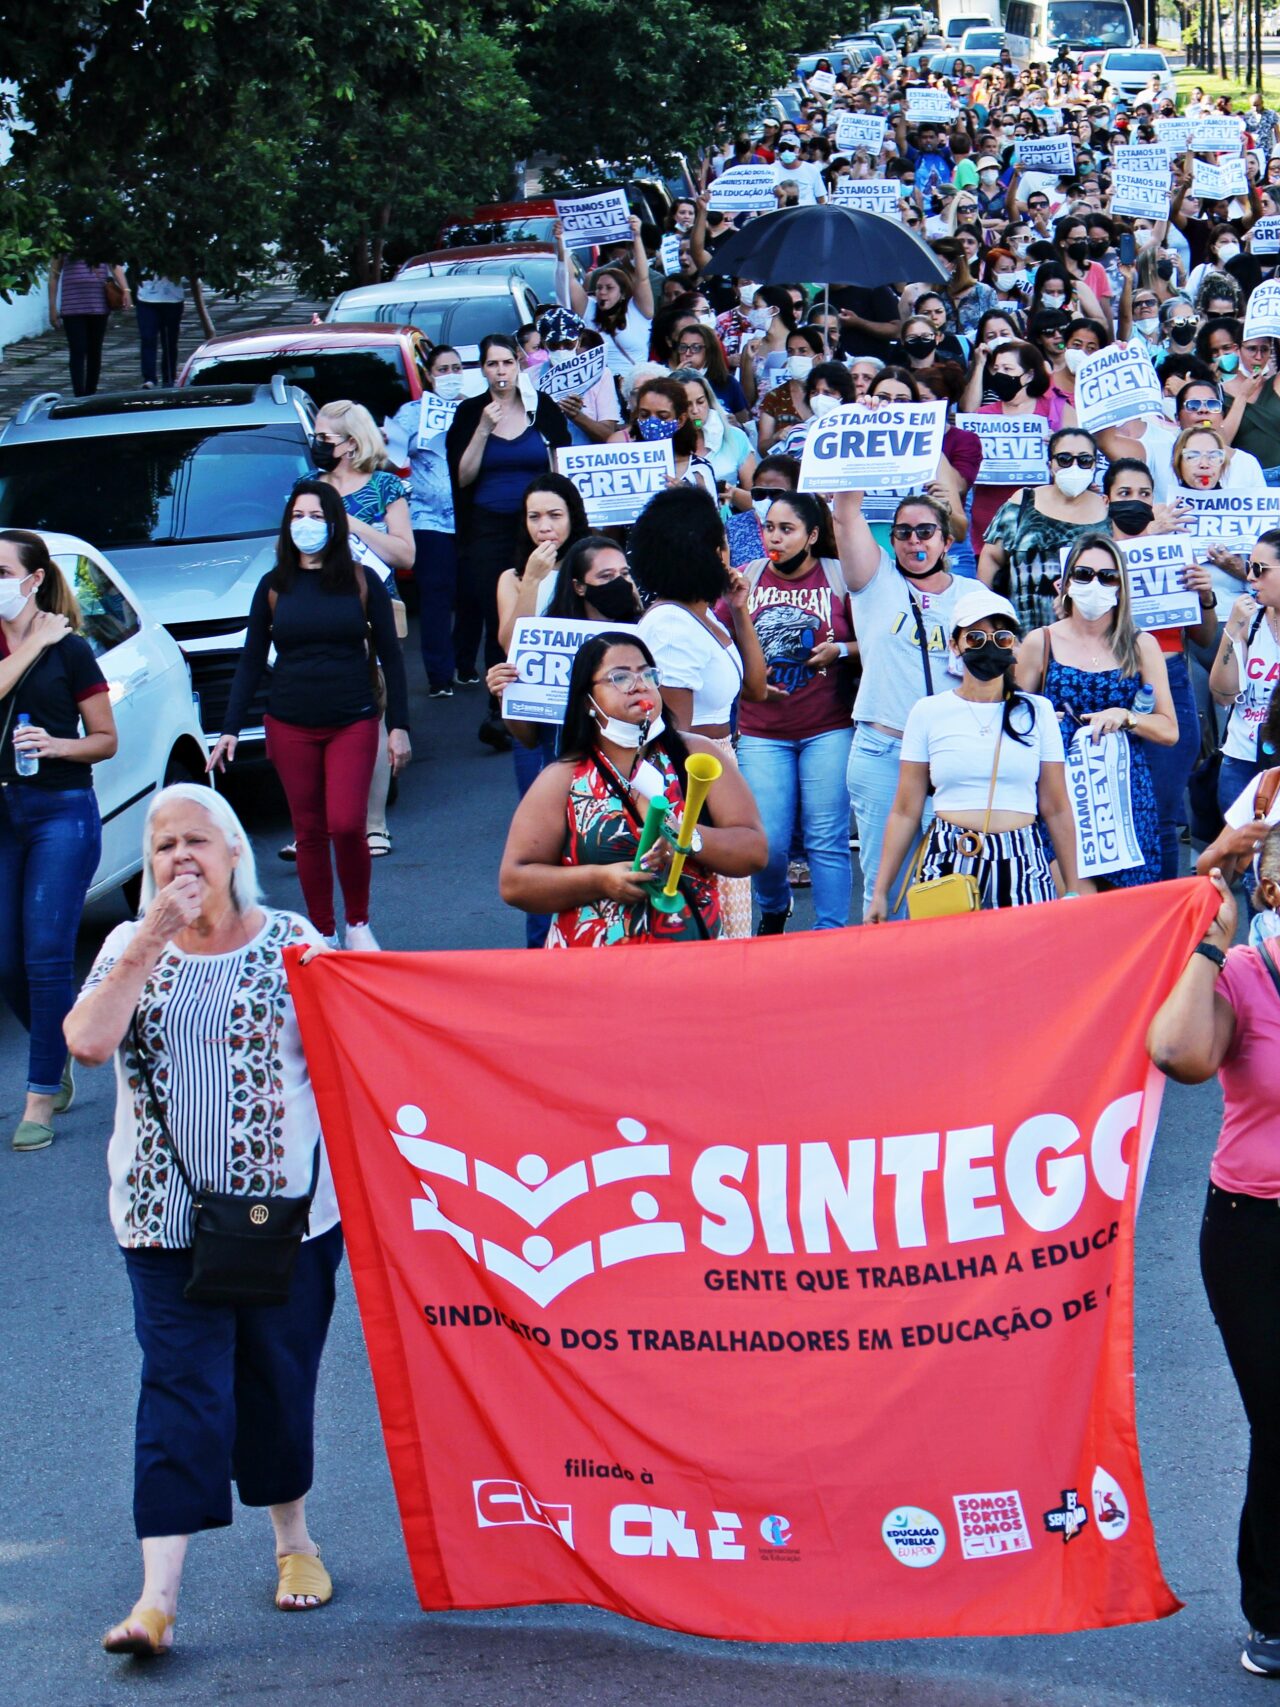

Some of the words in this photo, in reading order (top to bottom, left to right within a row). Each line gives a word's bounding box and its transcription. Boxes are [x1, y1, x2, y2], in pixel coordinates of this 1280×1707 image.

[911, 100, 950, 111] GREVE
[842, 117, 870, 127] ESTAMOS
[840, 126, 882, 140] GREVE
[1196, 127, 1239, 139] GREVE
[1020, 145, 1056, 153] ESTAMOS
[1058, 142, 1068, 151] EM
[1117, 148, 1155, 157] ESTAMOS
[1157, 148, 1167, 156] EM
[1021, 152, 1069, 166] GREVE
[1119, 157, 1168, 172] GREVE
[1116, 174, 1153, 186] ESTAMOS
[1155, 178, 1167, 188] EM
[1199, 170, 1242, 186] GREVE
[724, 188, 763, 198] EDUCAÇÃO
[833, 186, 879, 195] ESTAMOS
[882, 185, 895, 194] EM
[1117, 184, 1168, 204] GREVE
[559, 201, 604, 213] ESTAMOS
[606, 198, 621, 208] EM
[563, 210, 626, 231] GREVE
[540, 353, 588, 386] ESTAMOS
[589, 346, 604, 360] EM
[1080, 348, 1139, 379] ESTAMOS
[818, 411, 905, 430] ESTAMOS
[909, 411, 936, 426] EM
[963, 422, 1021, 434] ESTAMOS
[1023, 422, 1042, 434] EM
[813, 430, 934, 460] GREVE
[982, 437, 1043, 459] REVE
[566, 451, 641, 470] ESTAMOS
[644, 449, 666, 463] EM
[572, 468, 668, 498] GREVE
[1176, 496, 1253, 512] ESTAMOS
[1257, 497, 1280, 511] EM
[1158, 543, 1184, 561] EM
[1130, 565, 1184, 599] EVE
[1068, 737, 1083, 767] EM
[1087, 734, 1119, 862] GREVE
[1070, 771, 1095, 868] ESTAMOS
[704, 1269, 788, 1292] GENTE
[796, 1269, 849, 1294] QUE
[857, 1254, 998, 1289] TRABALHA
[1005, 1252, 1024, 1274] A
[1032, 1221, 1119, 1269] EDUCA
[424, 1304, 551, 1348] SINDICATO
[560, 1327, 619, 1351] DOS
[628, 1328, 849, 1353] TRABALHADORES
[858, 1329, 893, 1351] EM
[902, 1305, 1053, 1349] EDUCAÇÃO
[1063, 1290, 1098, 1321] DE
[565, 1459, 634, 1481] filiado
[640, 1469, 654, 1485] à
[959, 1496, 1017, 1511] SOMOS
[961, 1507, 1020, 1523] FORTES
[887, 1526, 939, 1538] EDUCAÇÃO
[963, 1519, 1022, 1537] SOMOS
